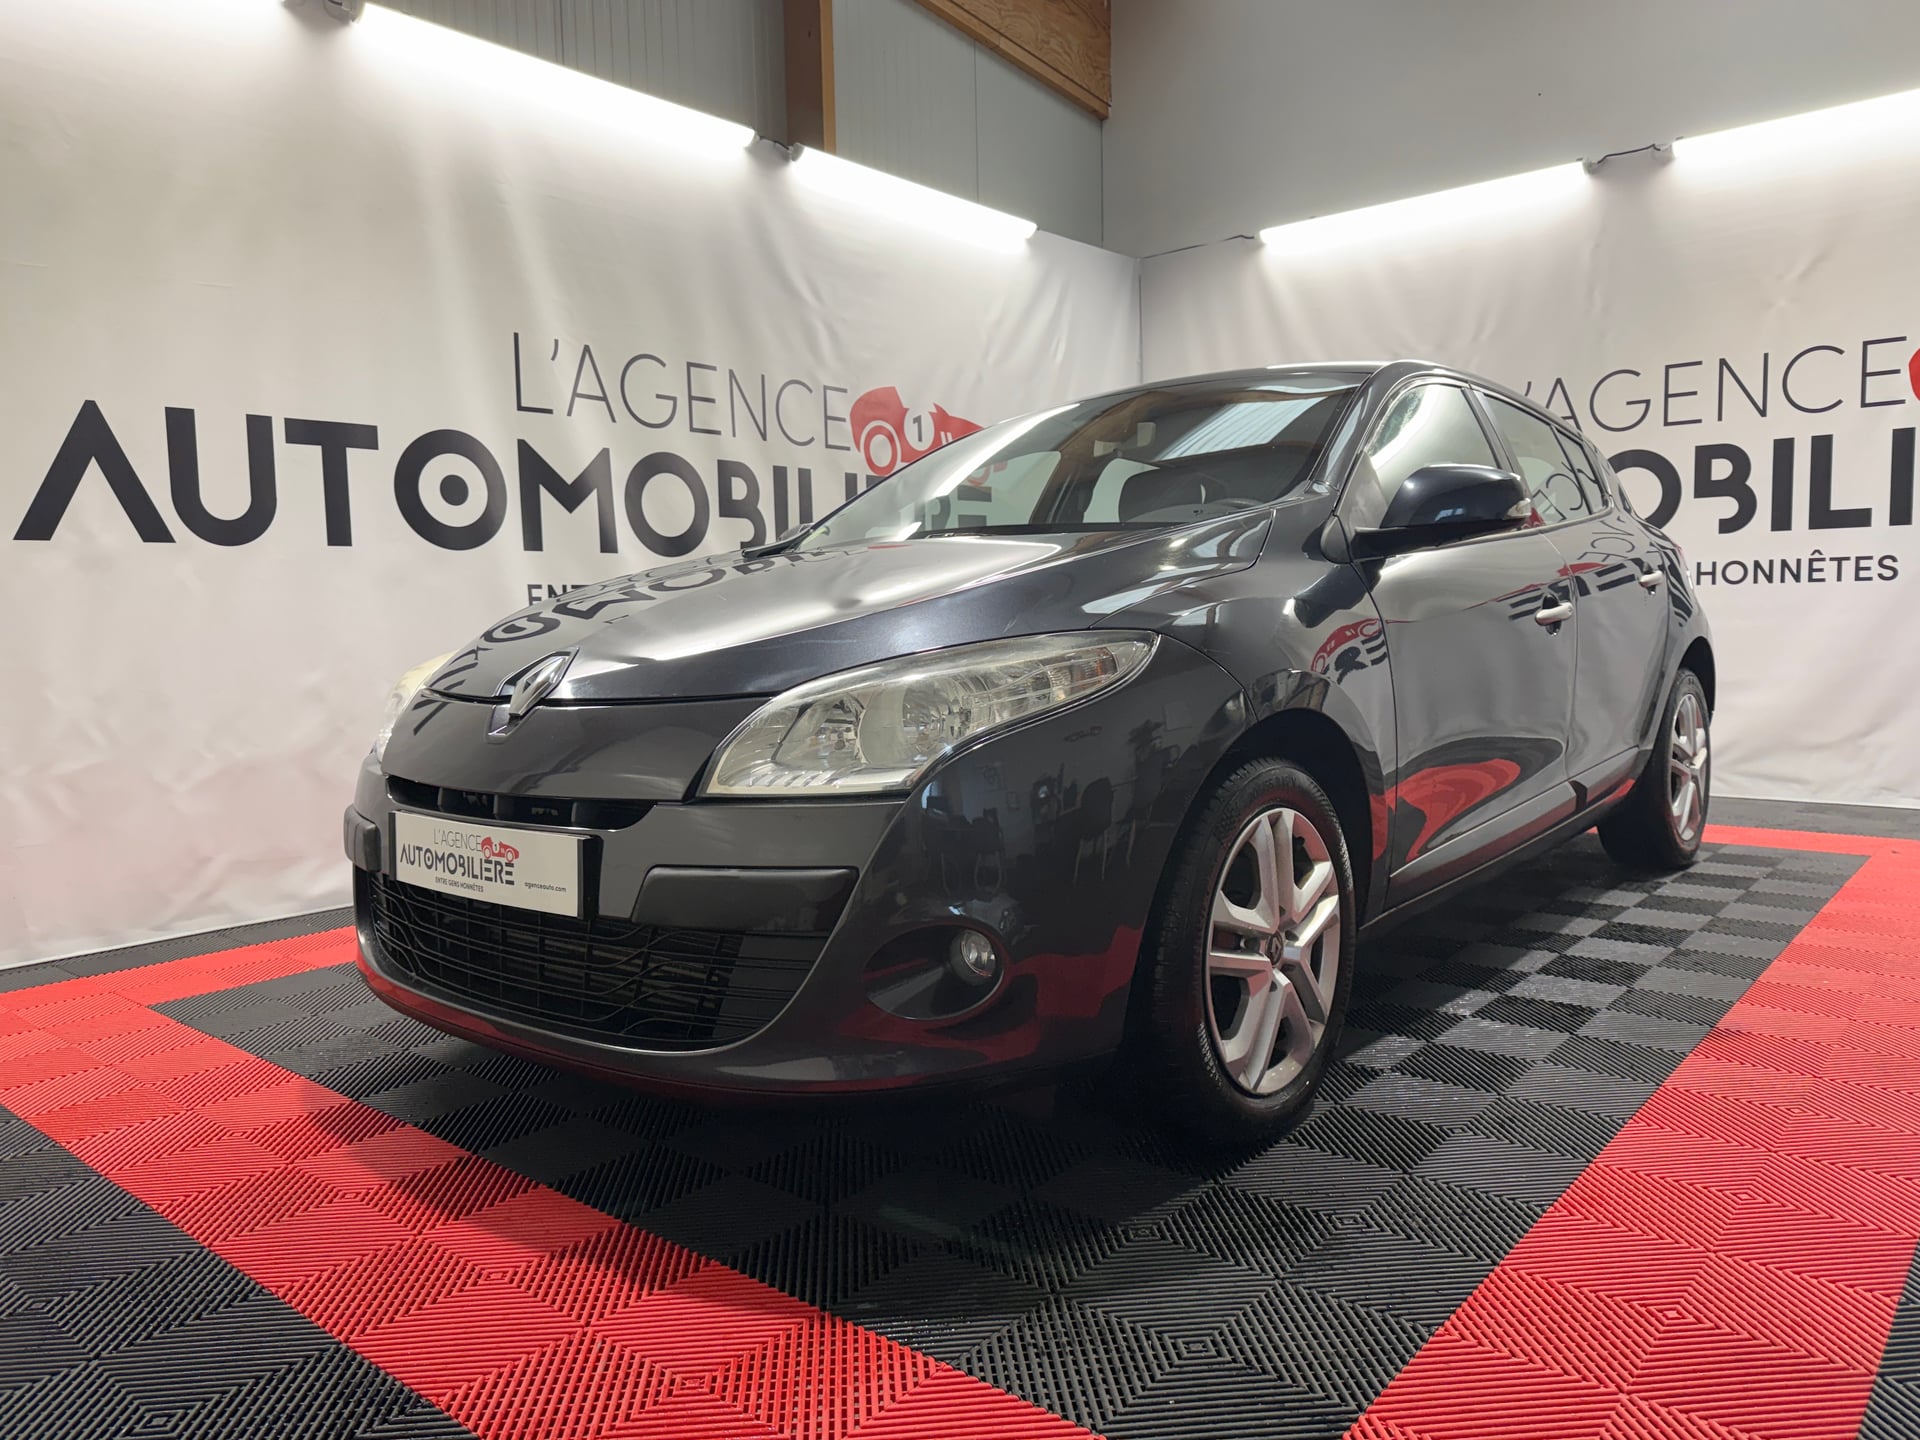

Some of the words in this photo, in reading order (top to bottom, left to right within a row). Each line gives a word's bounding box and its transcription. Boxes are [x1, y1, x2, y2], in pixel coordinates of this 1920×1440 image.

[512, 332, 851, 451] L'AGENCE
[912, 414, 923, 443] 1
[1695, 548, 1900, 586] HONNÊTES
[433, 828, 483, 852] L'AGENCE
[435, 876, 449, 887] ENTRE
[448, 879, 460, 889] GENS
[524, 881, 567, 893] agenceauto.com
